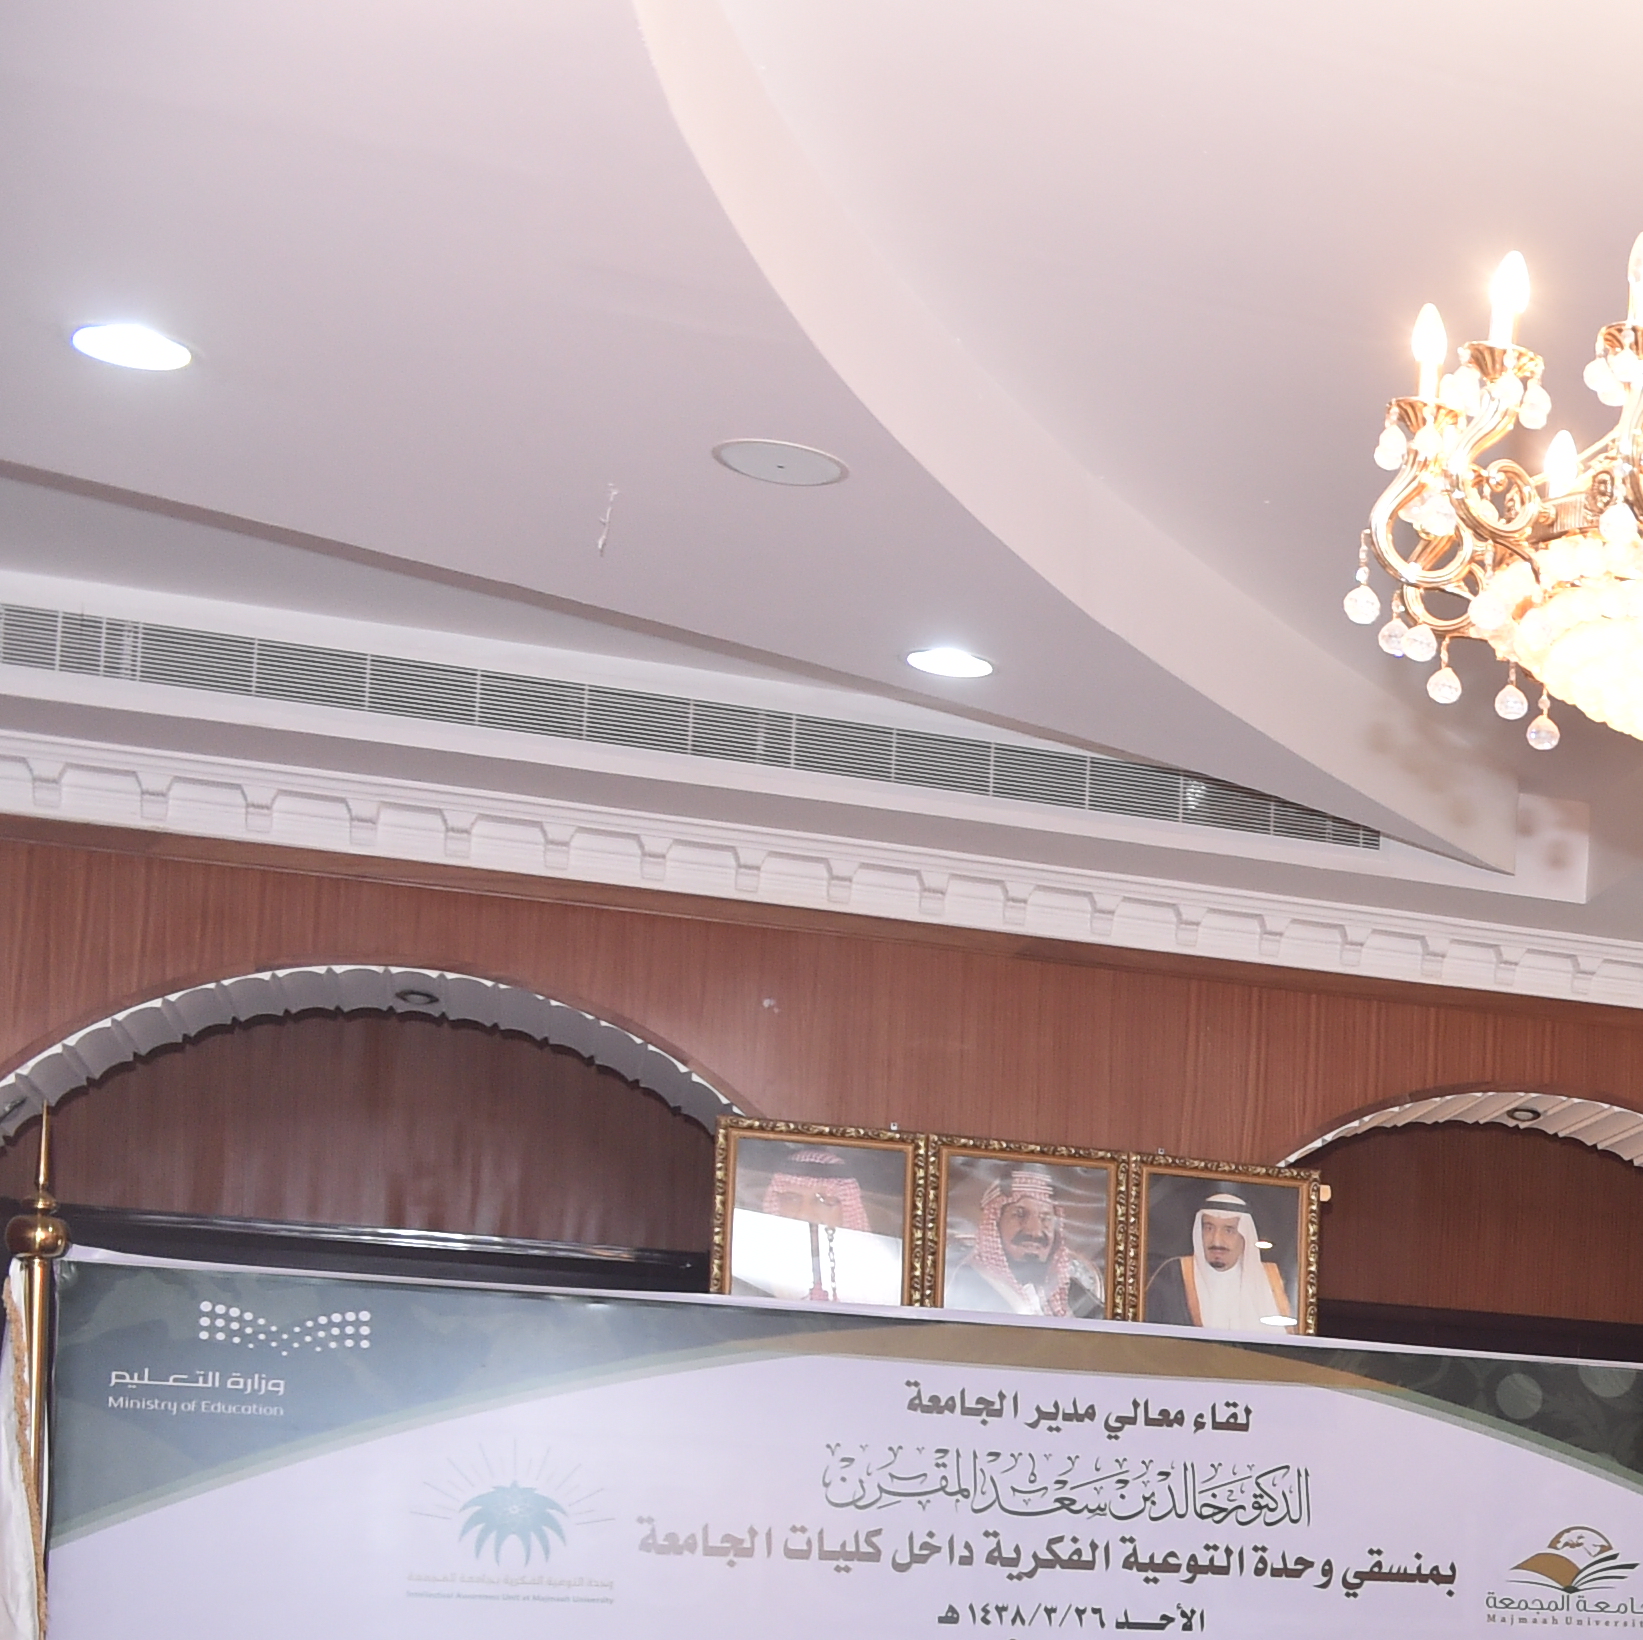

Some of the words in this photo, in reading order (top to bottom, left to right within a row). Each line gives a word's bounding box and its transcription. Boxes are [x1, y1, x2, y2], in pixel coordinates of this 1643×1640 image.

[108, 1396, 177, 1416] Ministry
[181, 1399, 197, 1412] of
[201, 1400, 284, 1417] Education
[227, 1372, 285, 1397] وزارة
[905, 1380, 1019, 1427] الجامعة
[1026, 1395, 1096, 1434] مدير
[1104, 1398, 1185, 1440] معالي
[1192, 1399, 1253, 1435] لقاء
[636, 1515, 773, 1568] الجامعة
[782, 1524, 884, 1574] كليات
[891, 1529, 974, 1573] داخل
[983, 1530, 1111, 1582] الفكرية
[1121, 1535, 1245, 1585] التوعية
[1252, 1545, 1335, 1589] وحدة
[1341, 1547, 1457, 1599] بمنسقي
[1485, 1591, 1570, 1615] المجمعة
[1486, 1614, 1559, 1627] Majmaah
